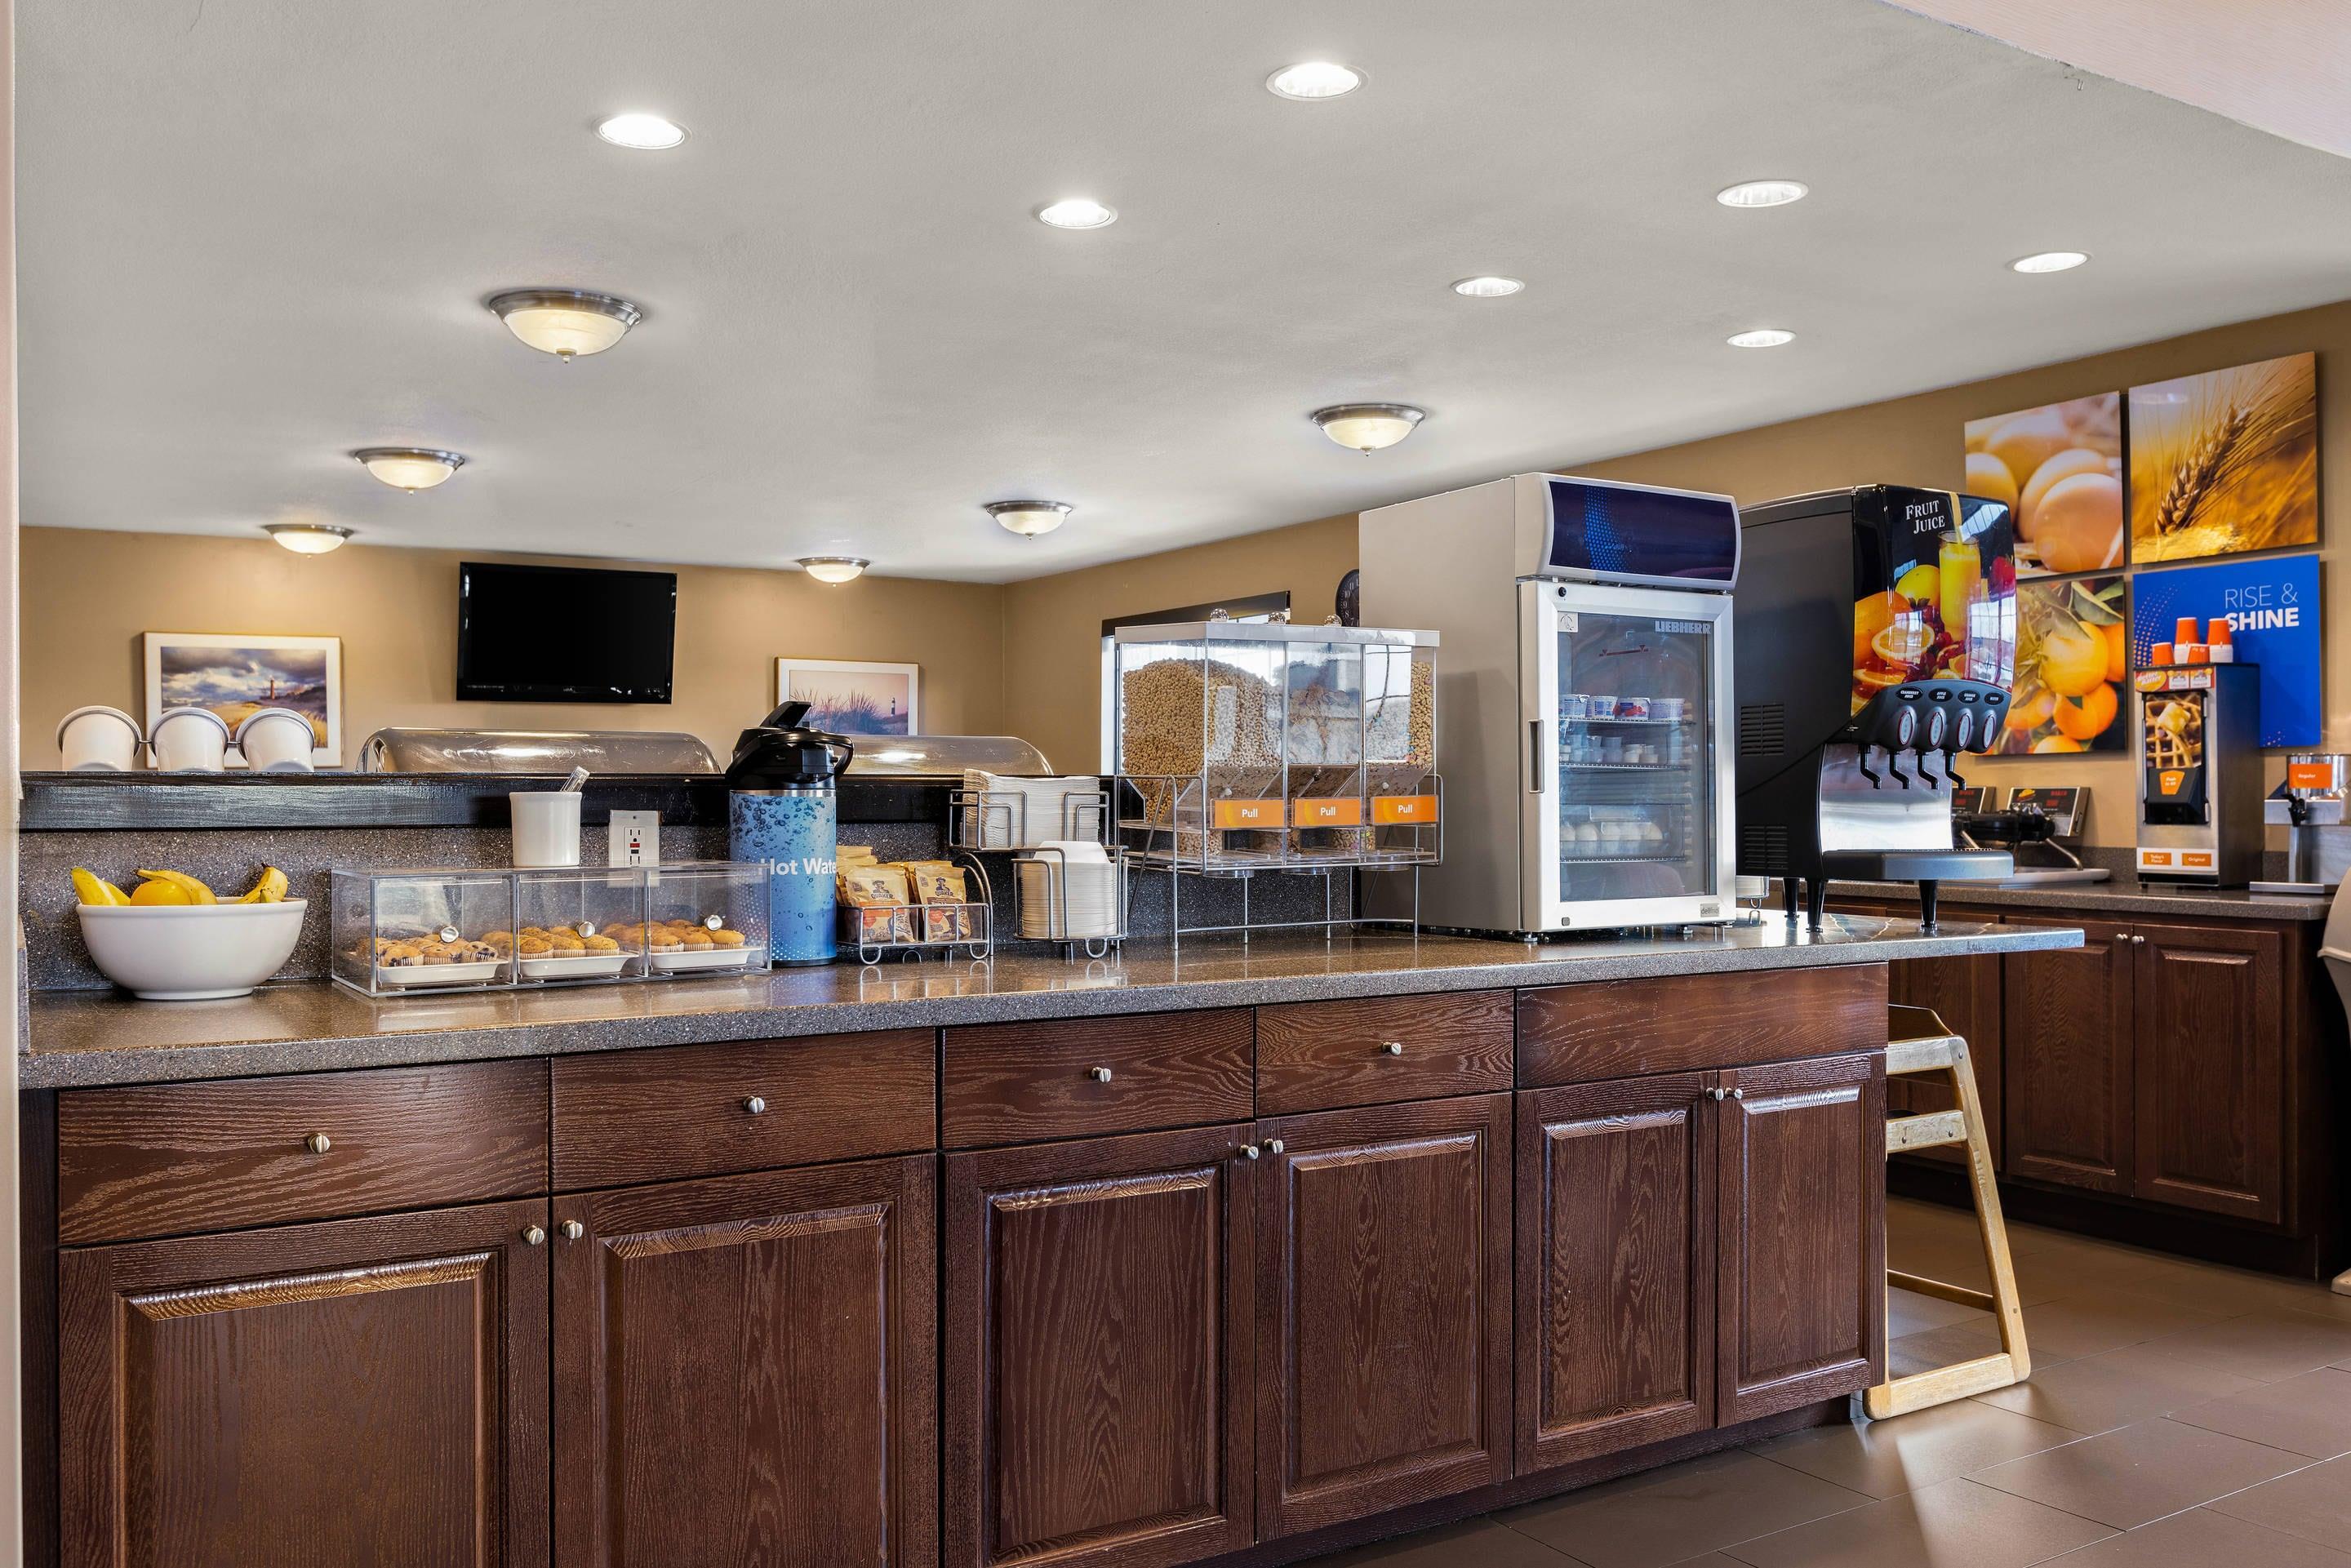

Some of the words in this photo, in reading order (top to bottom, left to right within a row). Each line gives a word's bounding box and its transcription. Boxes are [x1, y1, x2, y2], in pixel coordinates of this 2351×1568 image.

[1905, 500, 1940, 520] FRUIT
[1913, 516, 1945, 534] JUICE
[2224, 585, 2273, 609] RISE
[2281, 583, 2298, 604] &
[1655, 620, 1712, 635] LIEBHERR
[2224, 607, 2300, 632] SHINE
[1242, 808, 1258, 818] Pull
[1320, 806, 1336, 816] Pull
[1398, 805, 1413, 814] Pull
[802, 857, 837, 875] Wate
